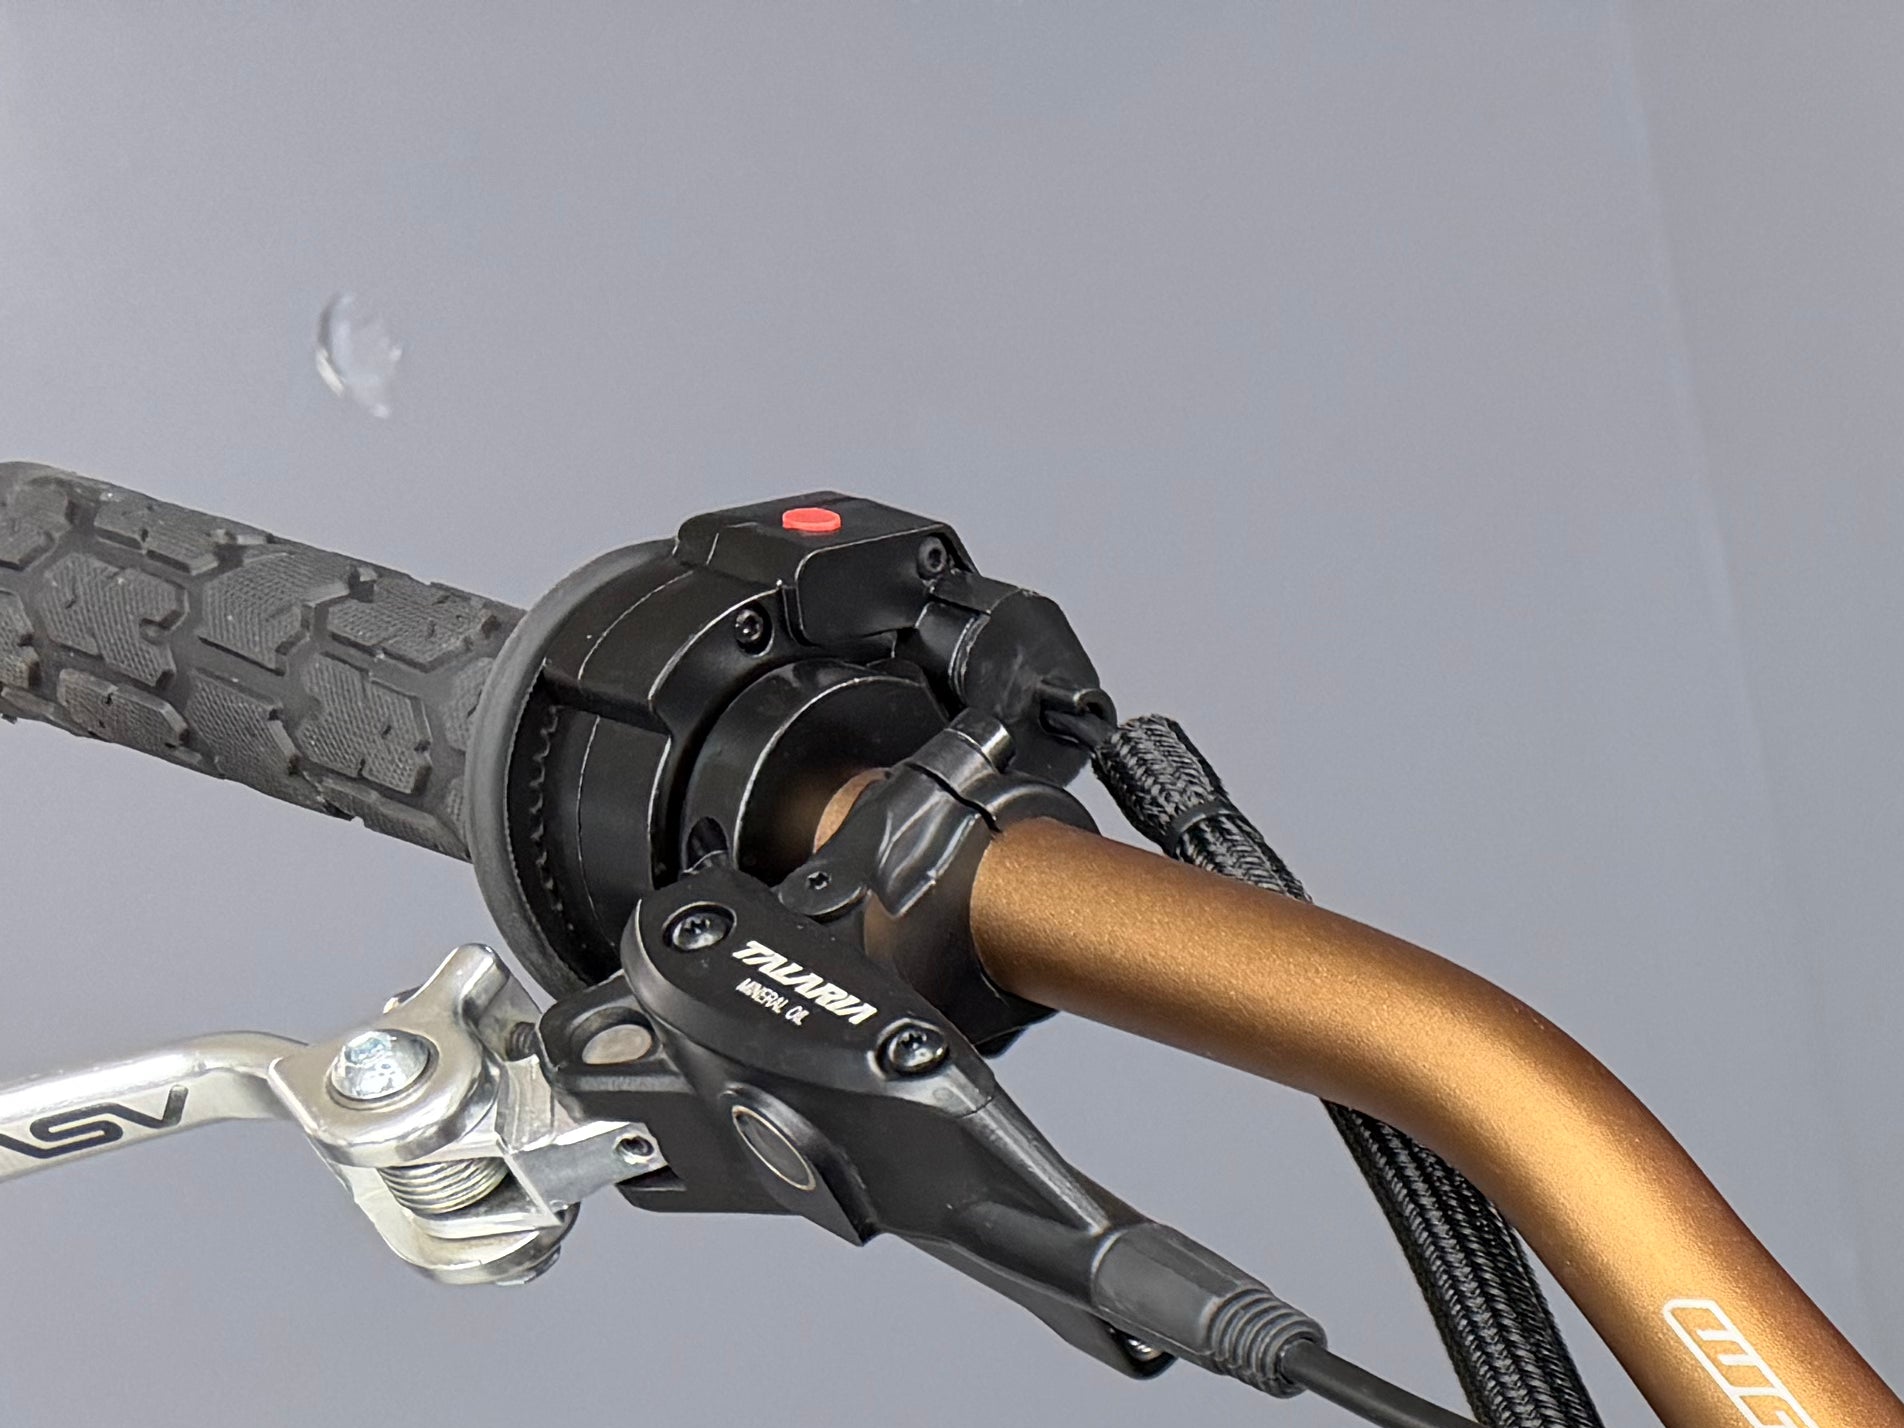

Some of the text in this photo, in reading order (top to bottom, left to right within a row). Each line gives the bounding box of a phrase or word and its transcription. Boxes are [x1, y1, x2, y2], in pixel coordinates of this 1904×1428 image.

[732, 940, 878, 1025] TALARIA
[735, 978, 810, 1026] MINERAL OIL
